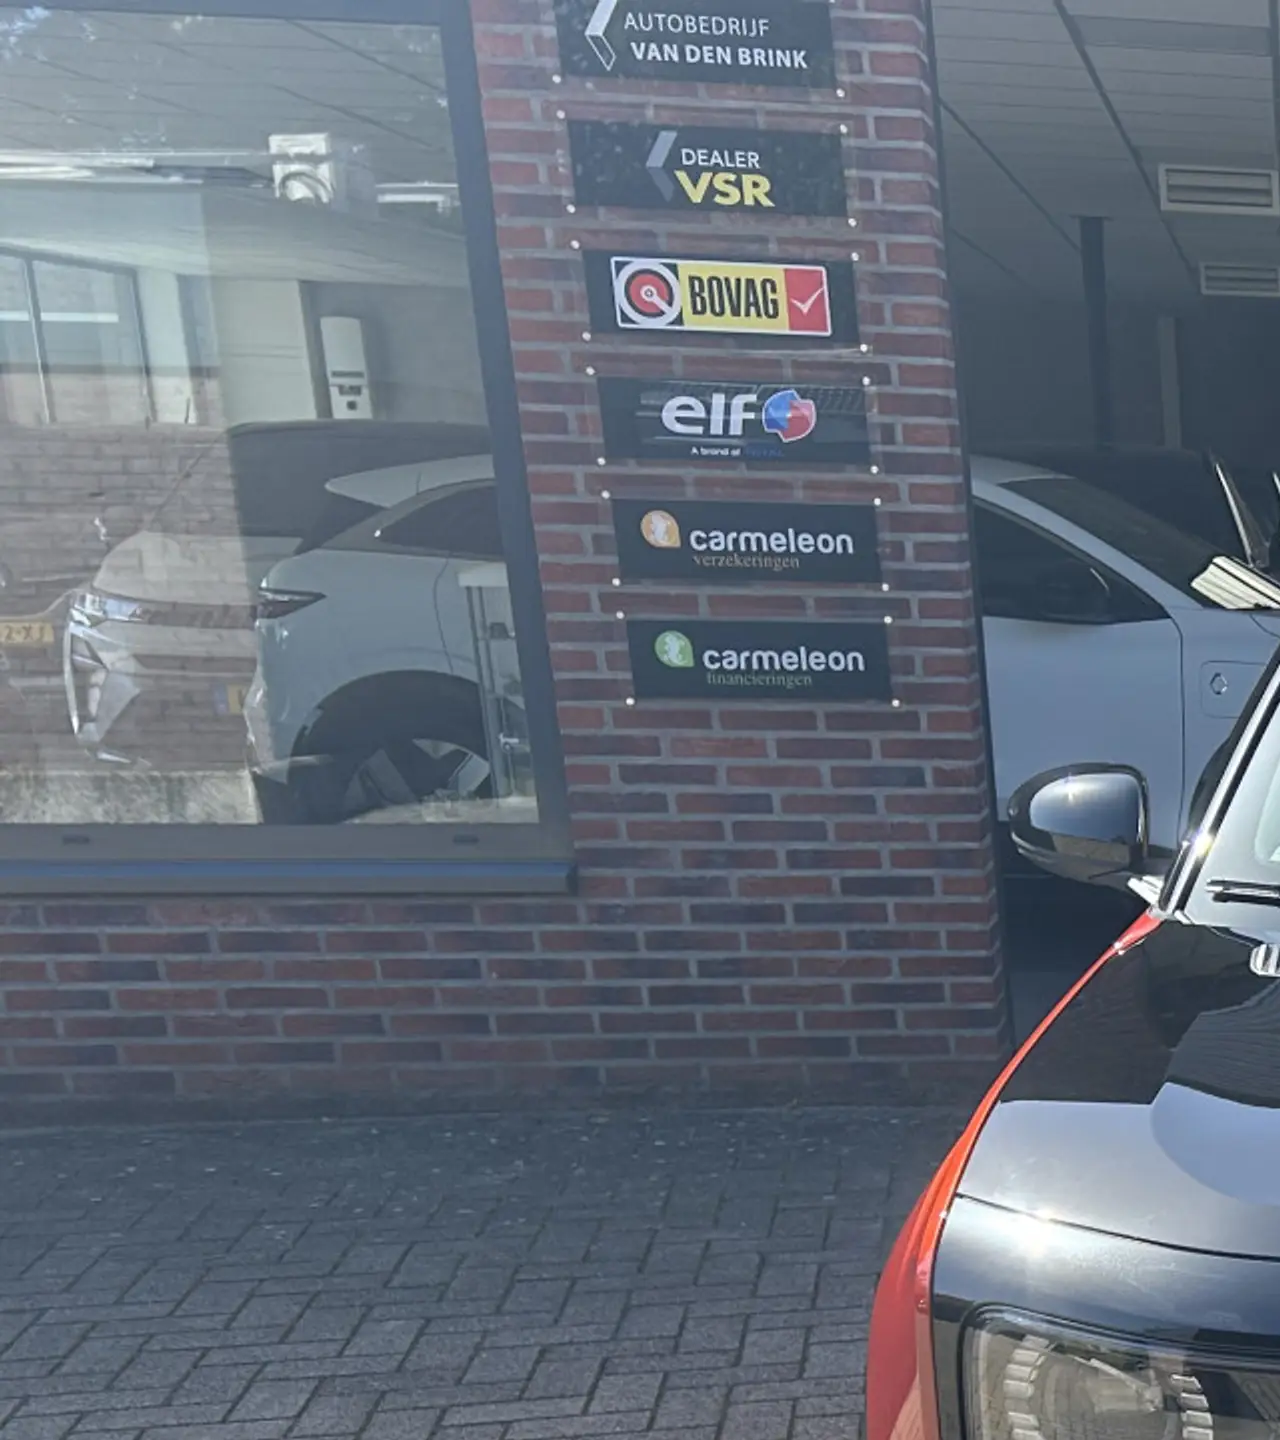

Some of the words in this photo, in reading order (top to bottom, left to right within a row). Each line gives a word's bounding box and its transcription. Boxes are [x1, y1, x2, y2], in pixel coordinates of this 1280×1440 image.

[624, 13, 769, 37] AUTOBEDRIJF
[630, 41, 679, 63] VAN
[685, 44, 732, 66] DEN
[738, 47, 809, 70] BRINK
[680, 148, 760, 169] DEALER
[674, 170, 776, 207] VSR
[688, 275, 779, 319] BOVAG
[661, 393, 757, 436] elf
[689, 528, 854, 555] carmeleon
[693, 553, 800, 571] verzekeringen
[703, 646, 866, 672] carmeleon
[707, 671, 813, 688] financieringen
